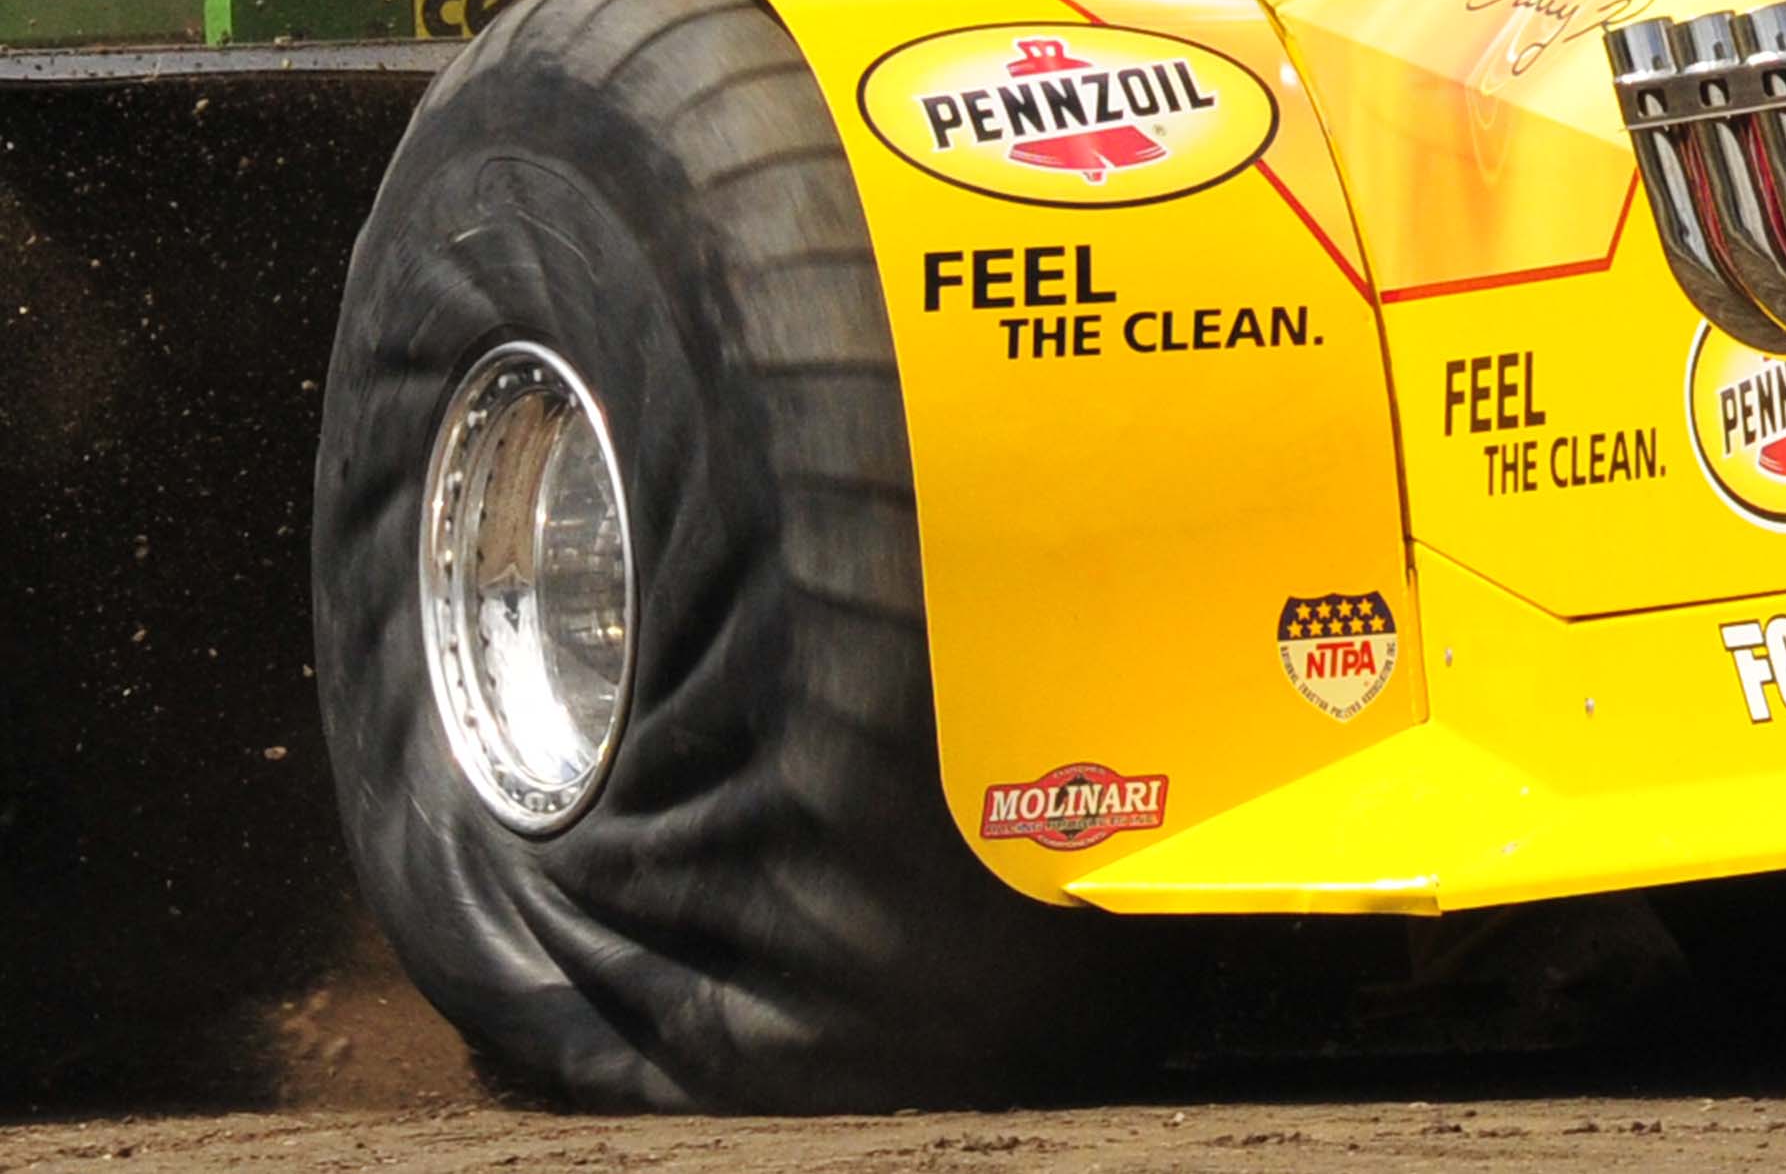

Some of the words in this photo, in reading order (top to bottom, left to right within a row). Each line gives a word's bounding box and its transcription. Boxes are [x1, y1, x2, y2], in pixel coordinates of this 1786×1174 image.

[922, 61, 1215, 151] PENNZOIL
[923, 244, 1116, 313] FEEL
[1000, 313, 1102, 360] THE
[1122, 306, 1324, 353] CLEAN.
[1444, 351, 1547, 437] FEEL
[1483, 439, 1538, 497] THE
[1551, 428, 1667, 489] CLEAN.
[1305, 639, 1377, 680] NTPA
[989, 780, 1163, 823] MOLINARI
